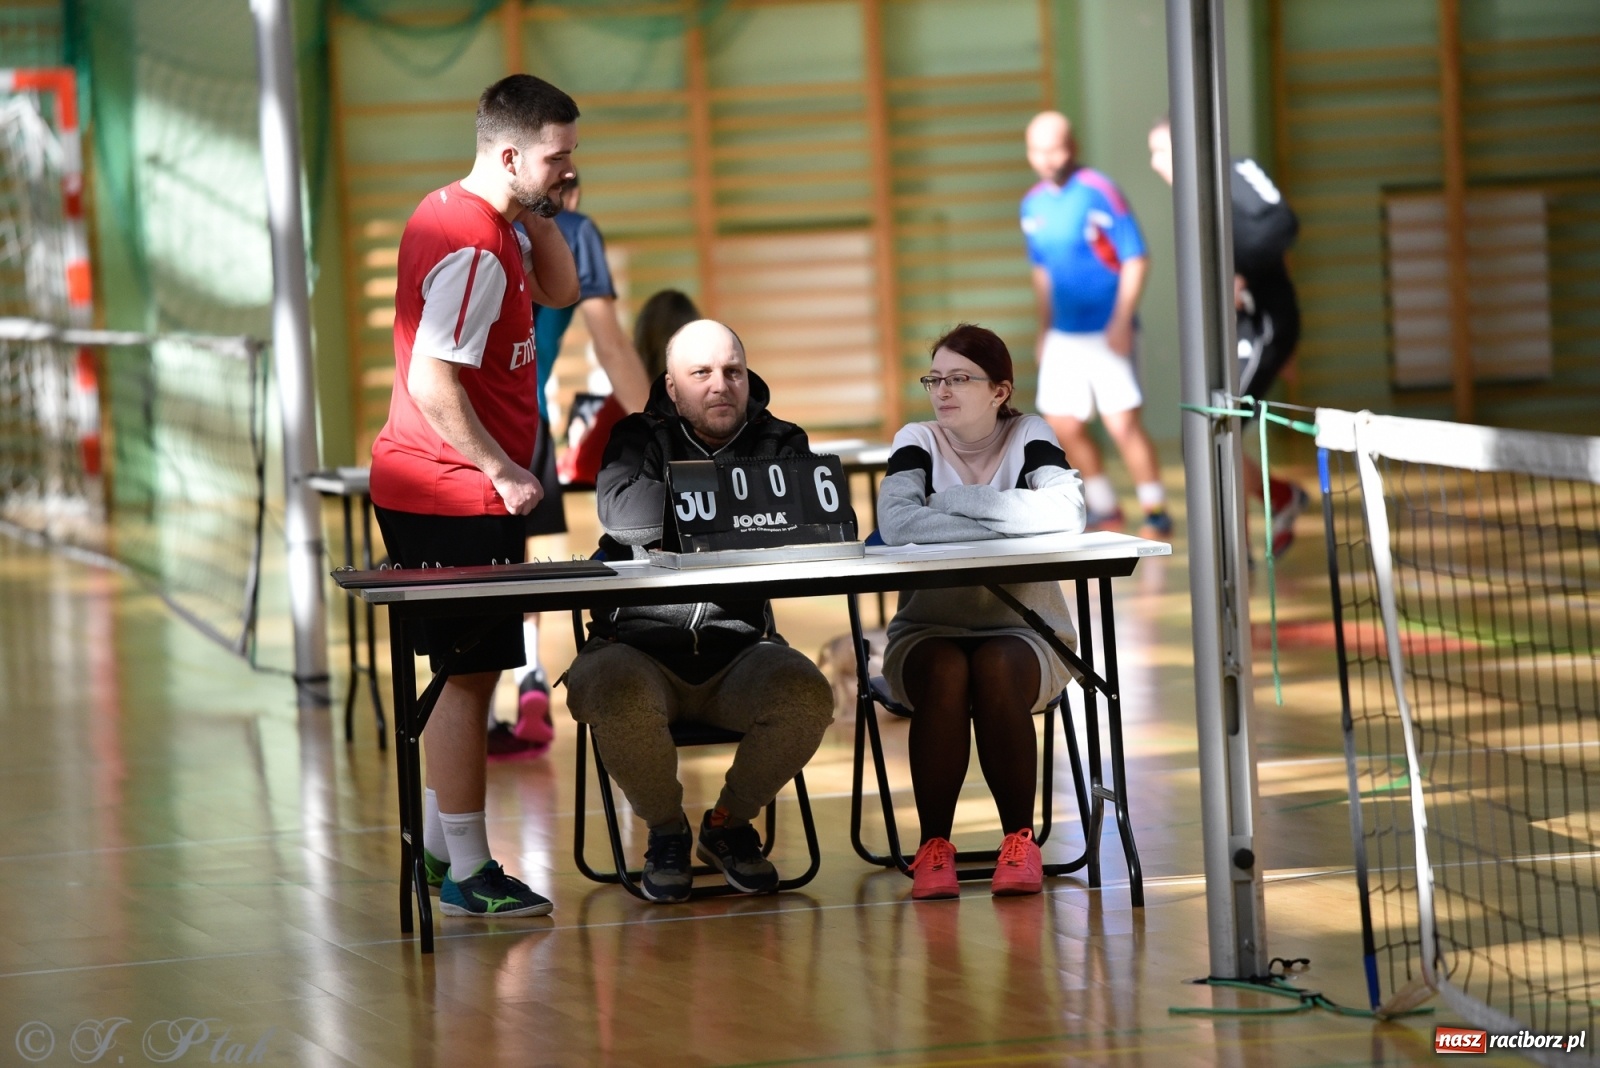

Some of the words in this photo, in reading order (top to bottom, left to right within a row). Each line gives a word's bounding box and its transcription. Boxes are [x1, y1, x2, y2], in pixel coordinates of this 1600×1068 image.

[731, 467, 748, 500] 0
[768, 464, 786, 497] 0
[813, 465, 840, 513] 6
[733, 512, 788, 528] JOOLA
